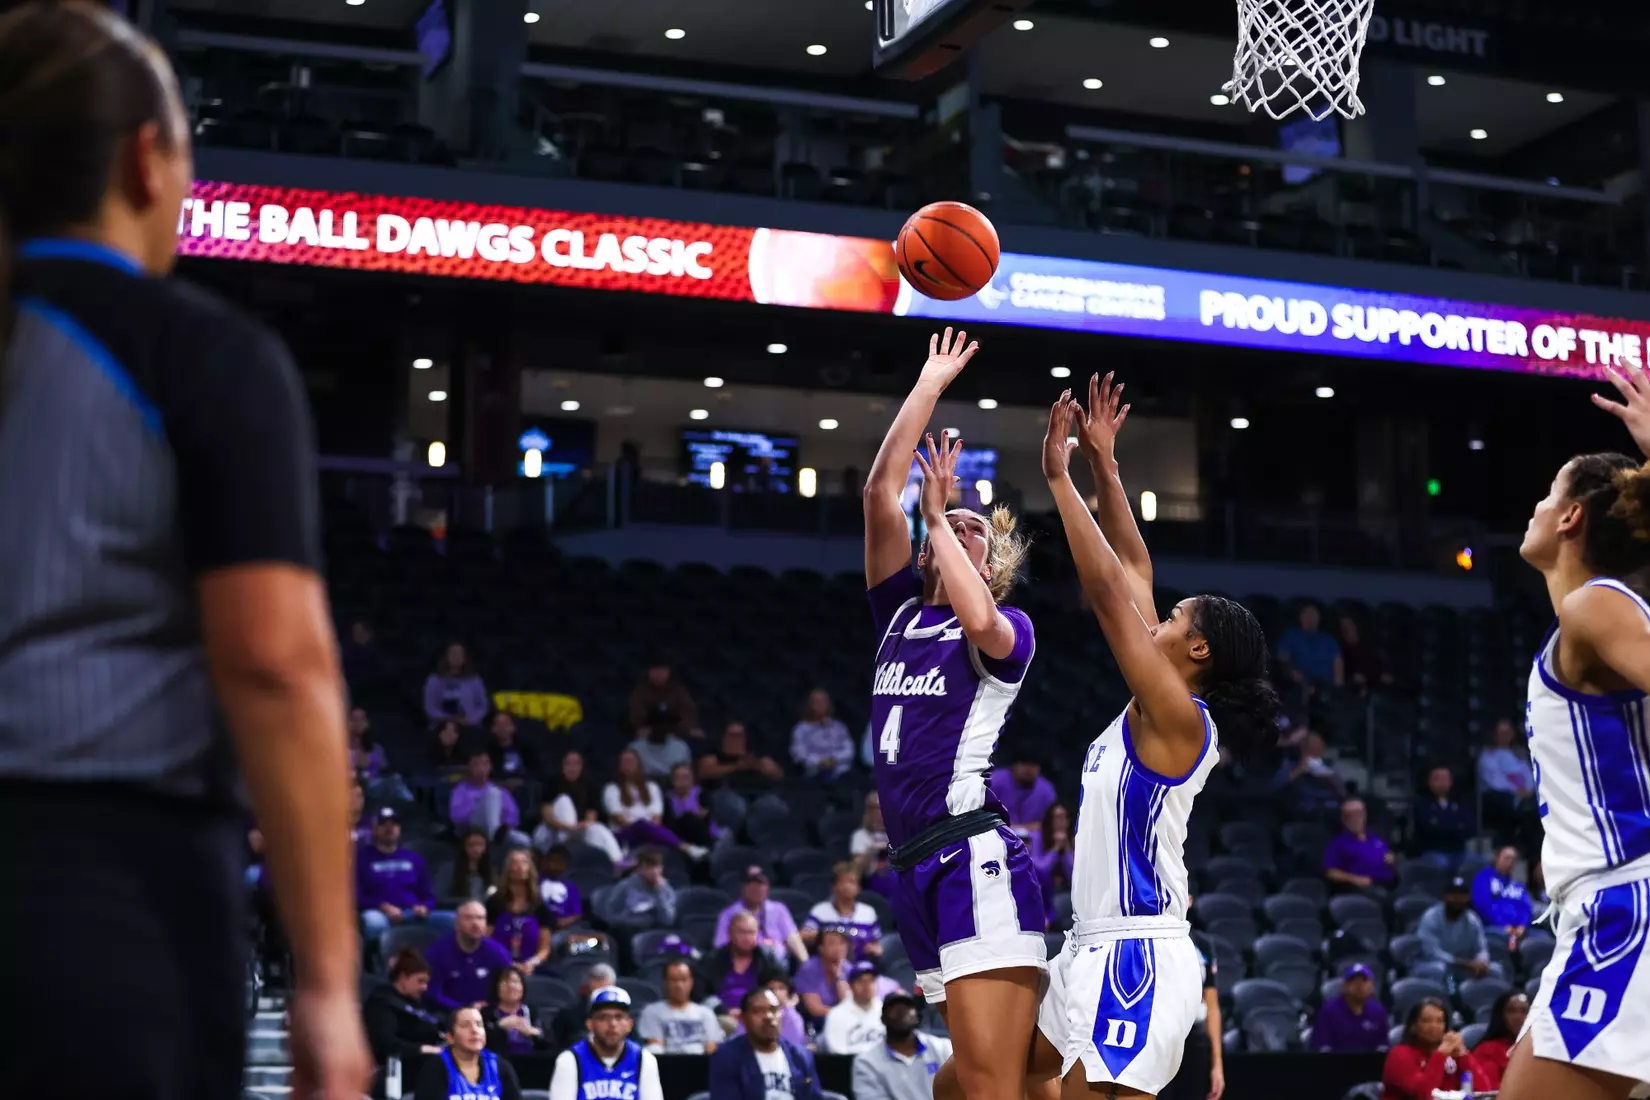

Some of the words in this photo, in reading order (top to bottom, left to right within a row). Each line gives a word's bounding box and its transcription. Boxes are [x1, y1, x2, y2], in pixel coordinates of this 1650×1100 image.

[1393, 18, 1489, 57] LIGHT
[177, 198, 250, 240] THE
[258, 204, 369, 250] BALL
[376, 214, 535, 263] DAWGS
[541, 229, 713, 279] CLASSIC
[1200, 290, 1328, 336] PROUD
[1331, 303, 1529, 357] SUPPORTER
[1531, 324, 1577, 361] OF
[1578, 328, 1643, 369] THE
[880, 705, 904, 764] 4
[1560, 984, 1607, 1024] D
[1103, 1018, 1137, 1048] D
[583, 1079, 638, 1100] DUKE
